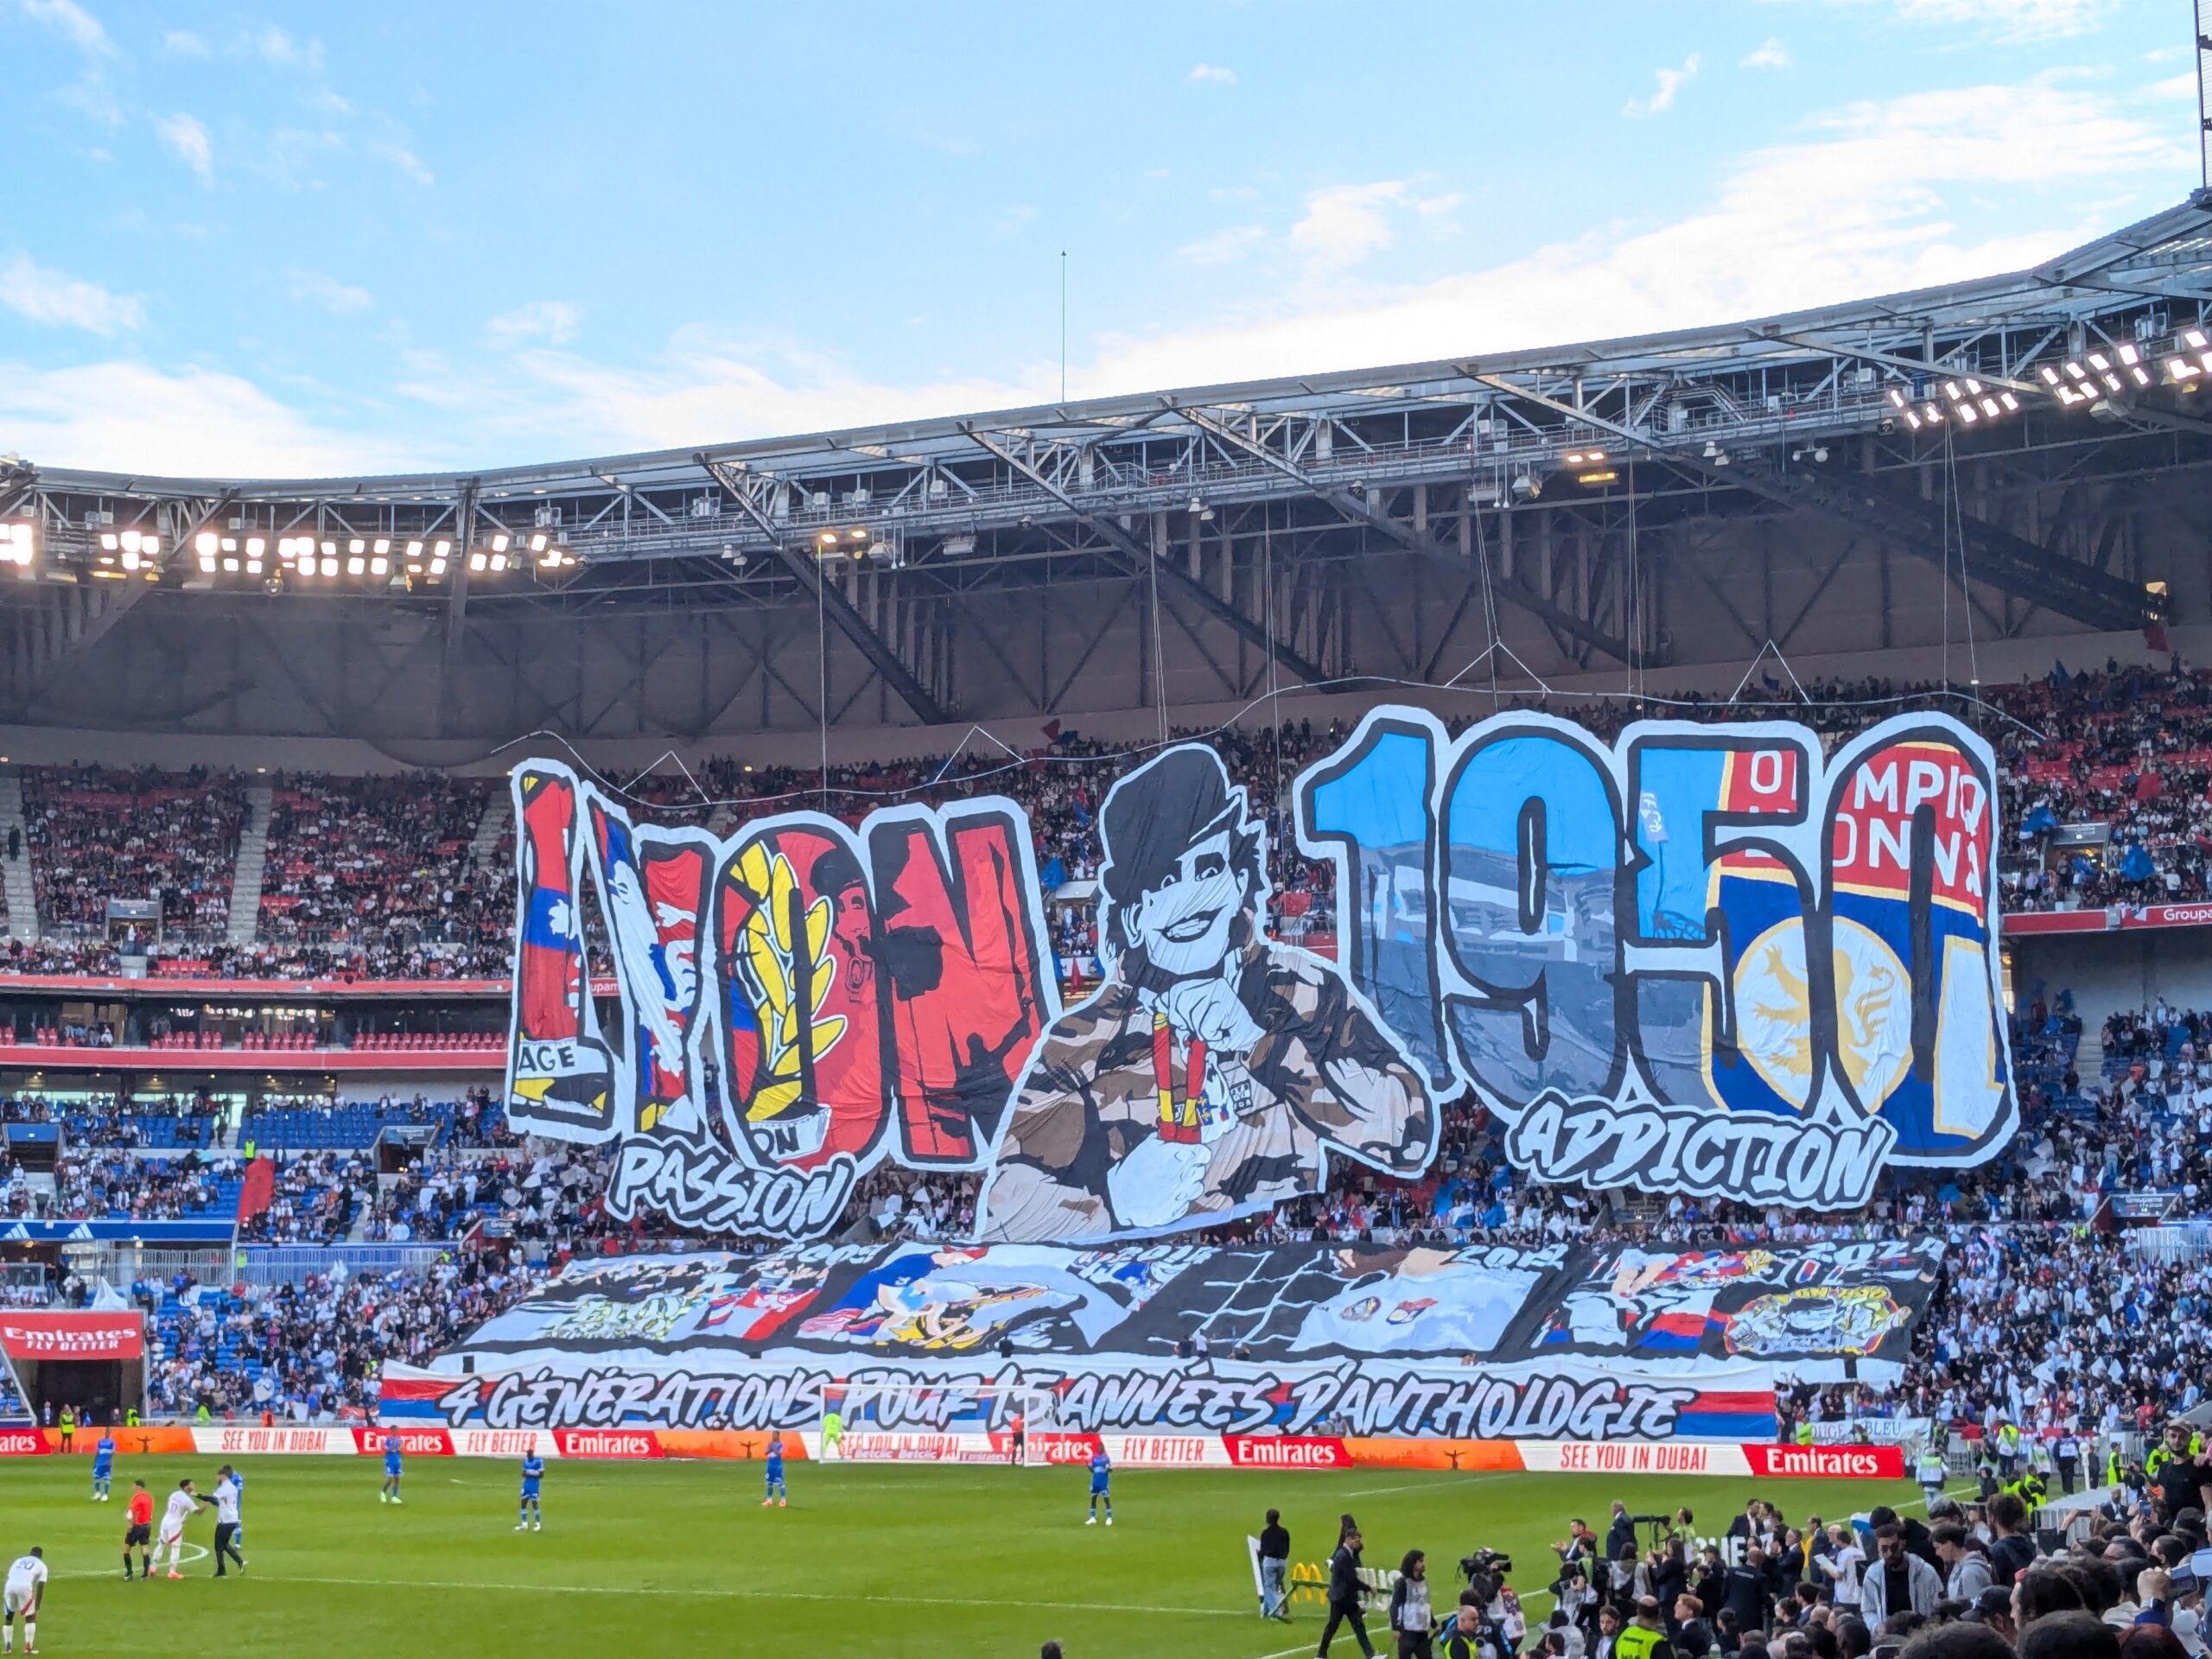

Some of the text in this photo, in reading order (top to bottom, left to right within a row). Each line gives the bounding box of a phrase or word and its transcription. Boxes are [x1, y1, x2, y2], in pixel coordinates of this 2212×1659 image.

[1515, 1097, 1889, 1203] ADDICTION
[611, 1141, 851, 1236] PASSION
[4, 1326, 137, 1342] Emirates
[26, 1339, 118, 1351] FLY BETTER
[436, 1376, 484, 1427] 4
[1061, 1359, 1278, 1433] ANNÉES
[222, 1429, 327, 1452] SEE YOU IN DUBAI
[467, 1432, 537, 1452] FLY BETTER
[566, 1433, 649, 1453] Emirates
[1124, 1438, 1205, 1461] FLY BETTER
[1238, 1440, 1336, 1464] Emirates
[1560, 1445, 1707, 1471] SEE YOU IN DUBAI
[1767, 1448, 1878, 1474] Emirates
